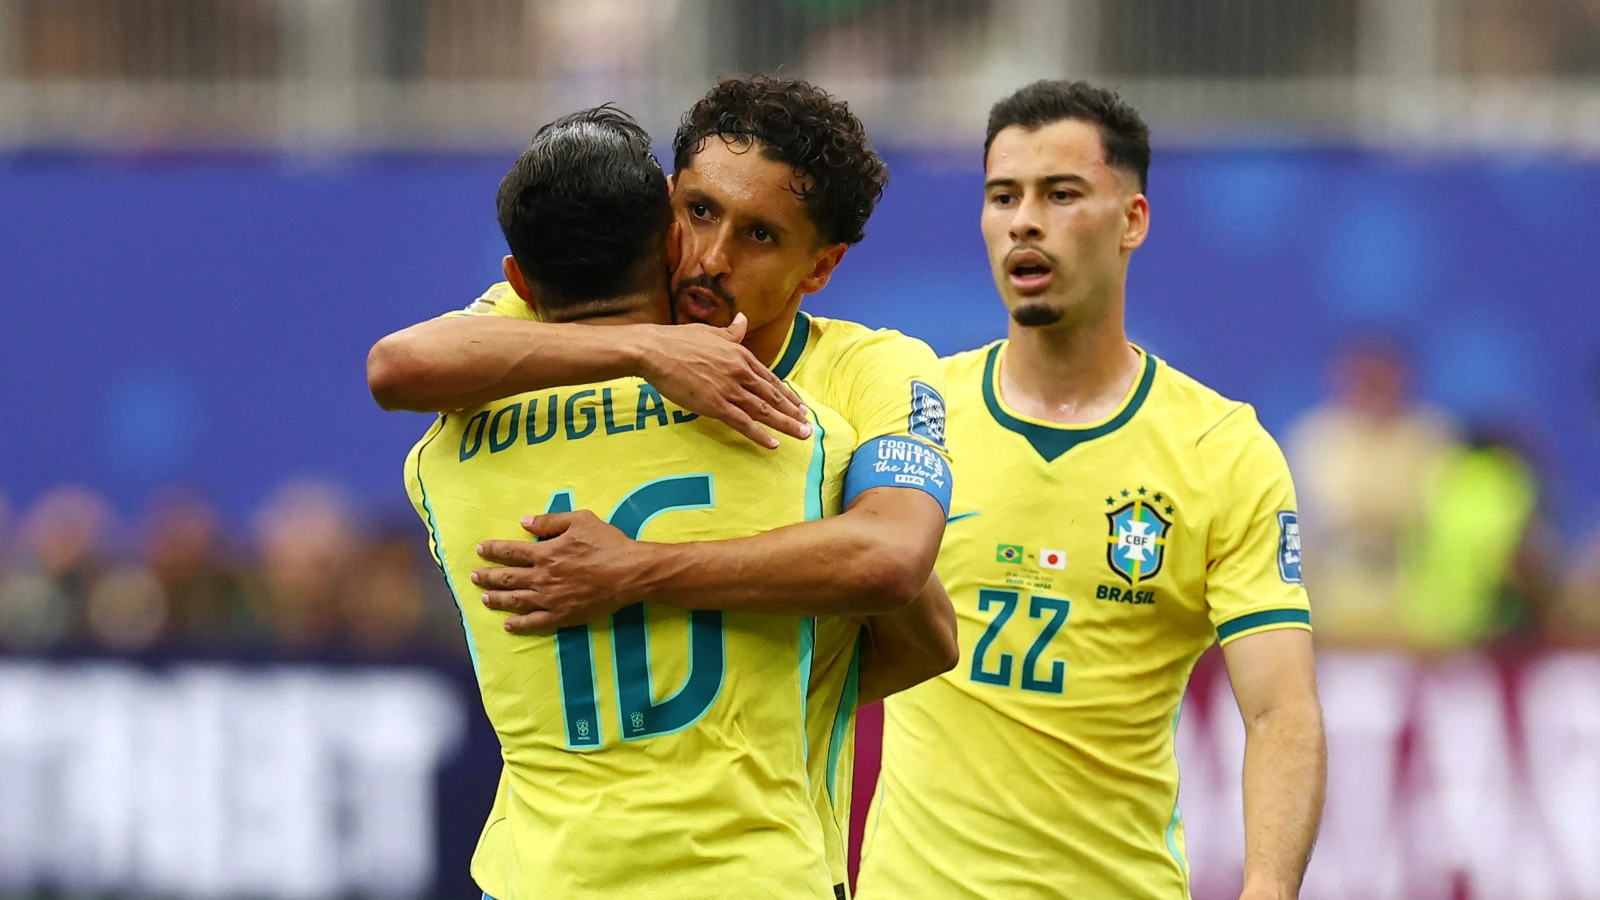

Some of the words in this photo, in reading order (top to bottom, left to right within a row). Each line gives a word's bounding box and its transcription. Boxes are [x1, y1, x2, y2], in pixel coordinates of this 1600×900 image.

[878, 448, 943, 477] UNITES
[879, 439, 943, 465] FOOTBALL
[872, 460, 901, 473] the
[903, 462, 944, 488] World
[898, 476, 922, 484] FIFA
[1124, 534, 1149, 547] CBF
[1095, 584, 1156, 605] BRASIL
[969, 588, 1071, 695] 22
